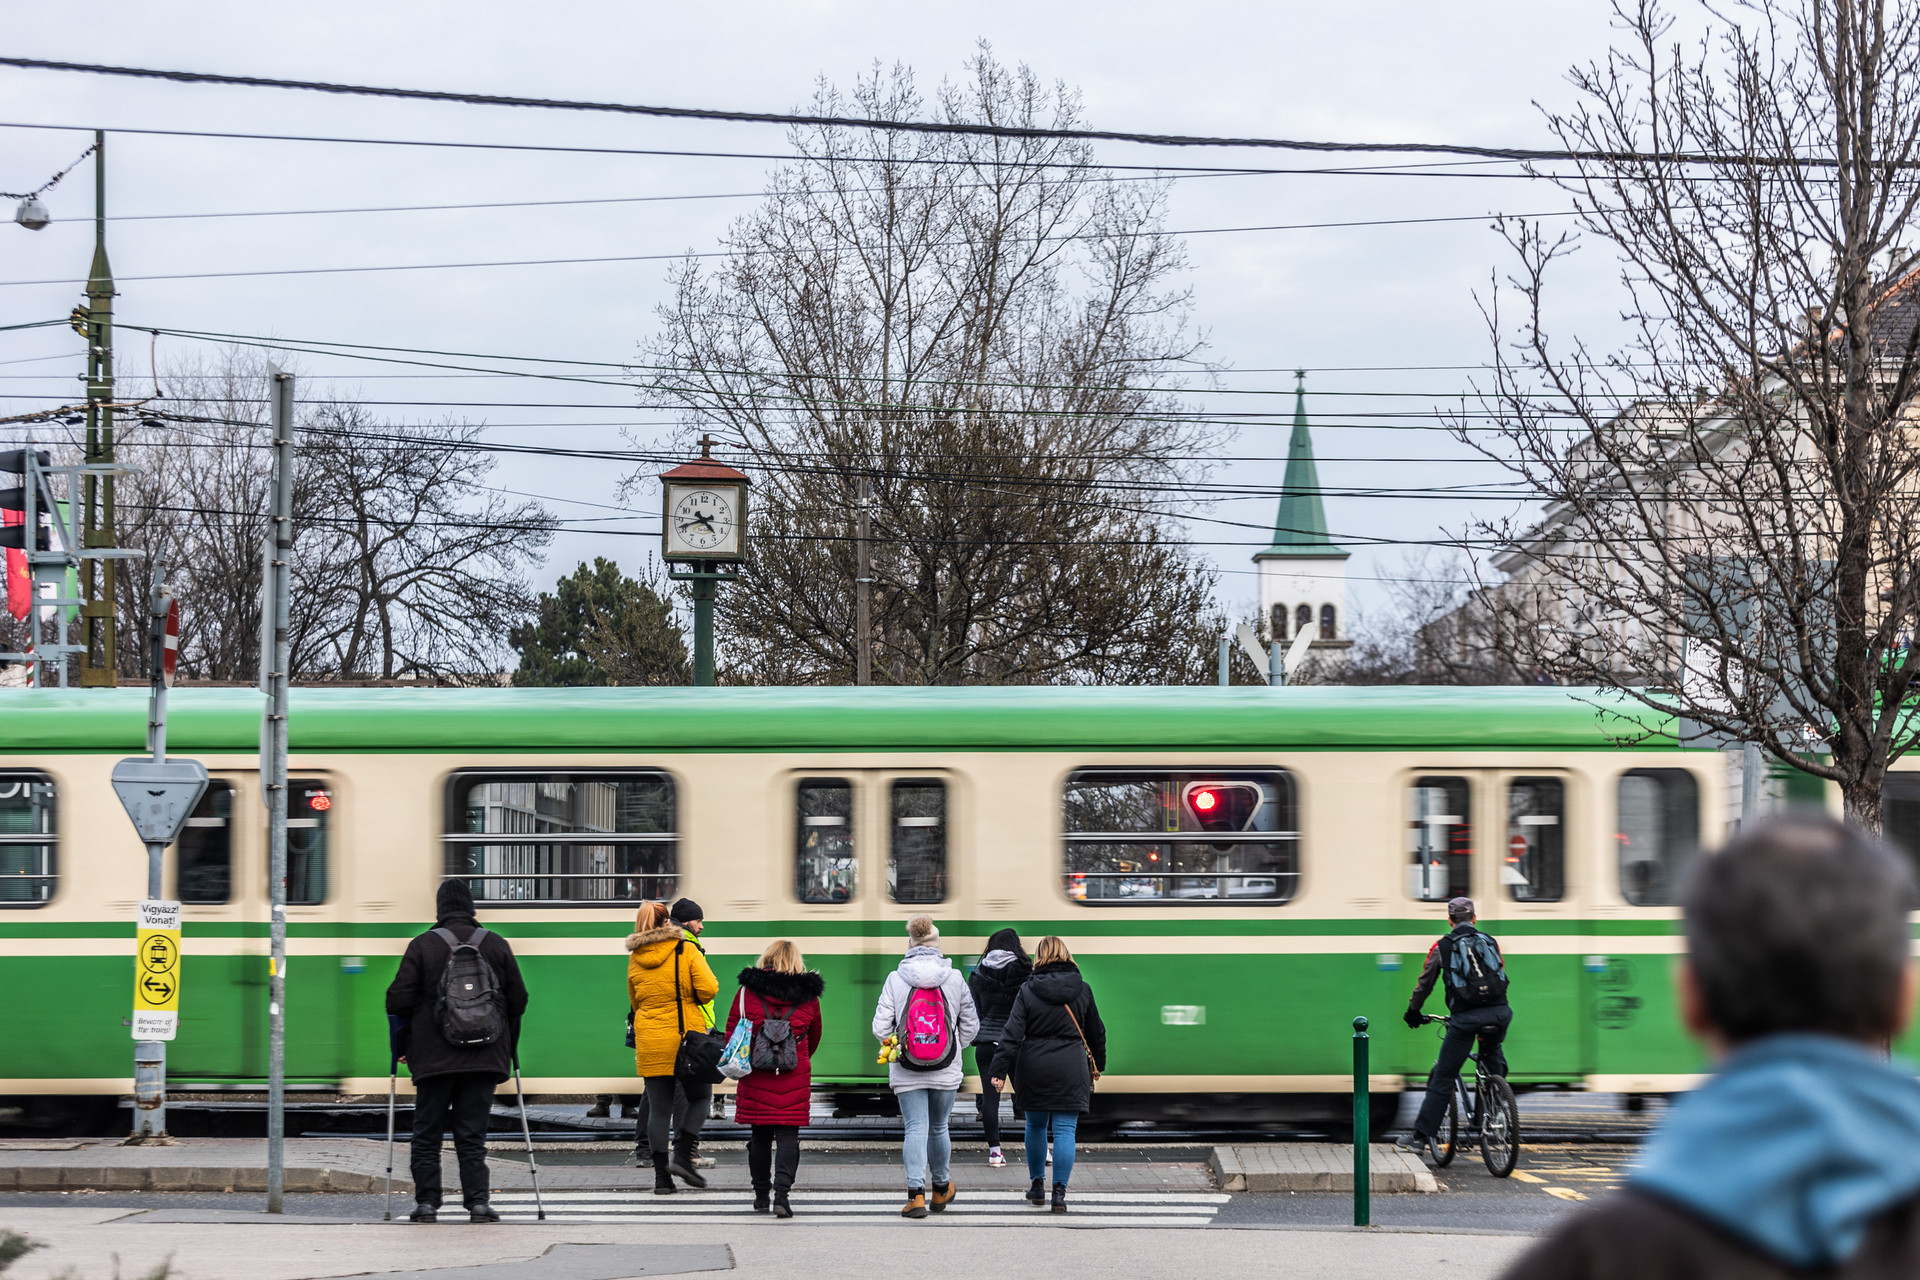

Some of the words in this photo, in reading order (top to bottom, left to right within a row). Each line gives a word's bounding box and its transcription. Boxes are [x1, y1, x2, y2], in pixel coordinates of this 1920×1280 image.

[142, 904, 179, 915] Vigyázz!
[145, 916, 176, 925] Vonat!
[914, 1035, 940, 1044] PUMA
